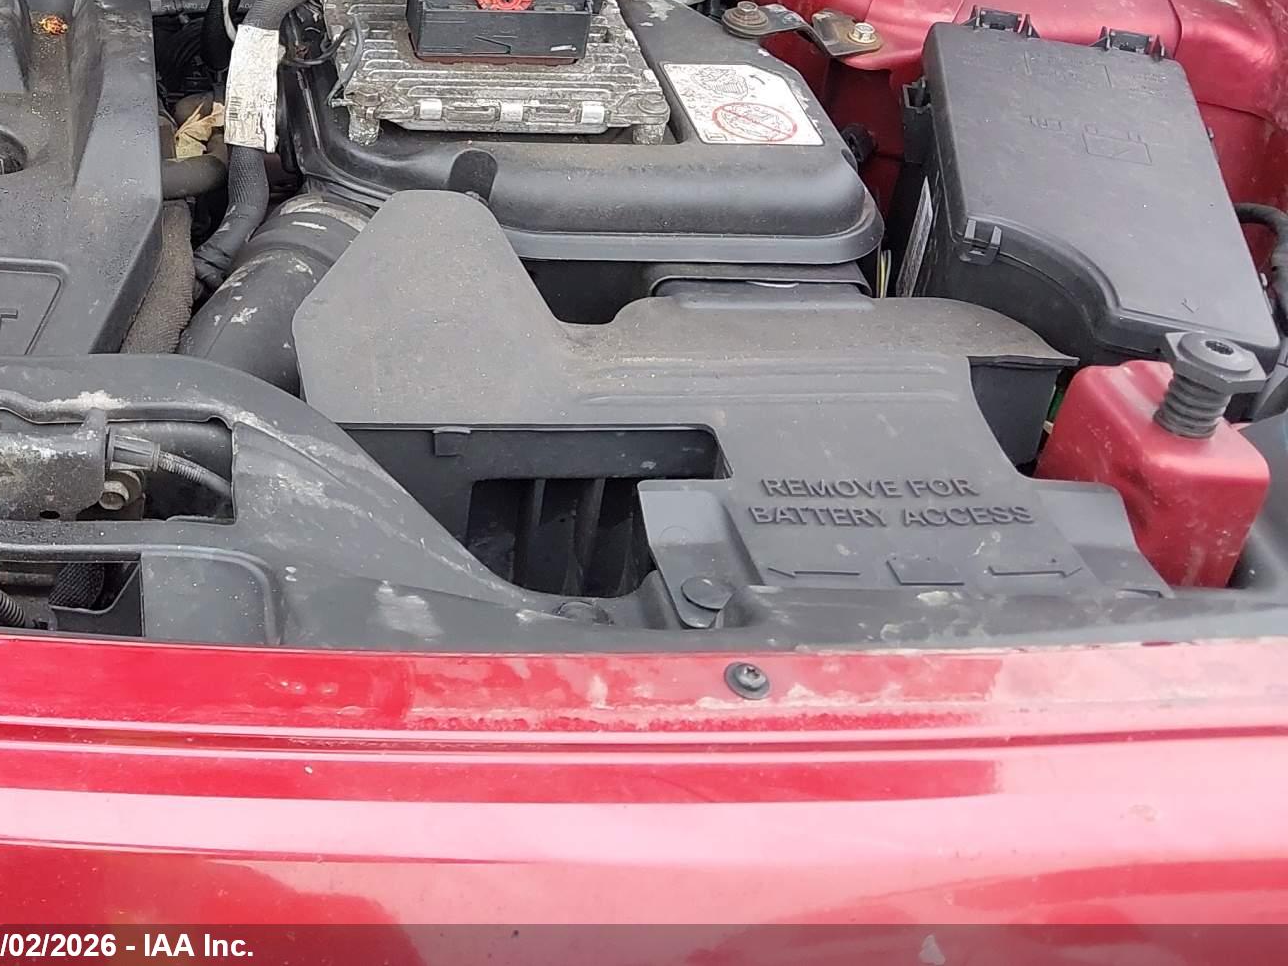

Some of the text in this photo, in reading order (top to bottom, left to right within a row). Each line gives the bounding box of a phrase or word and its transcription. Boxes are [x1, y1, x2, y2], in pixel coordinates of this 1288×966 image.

[762, 479, 980, 498] REMOVE FOR
[748, 506, 1035, 527] BATTERY ACCESS
